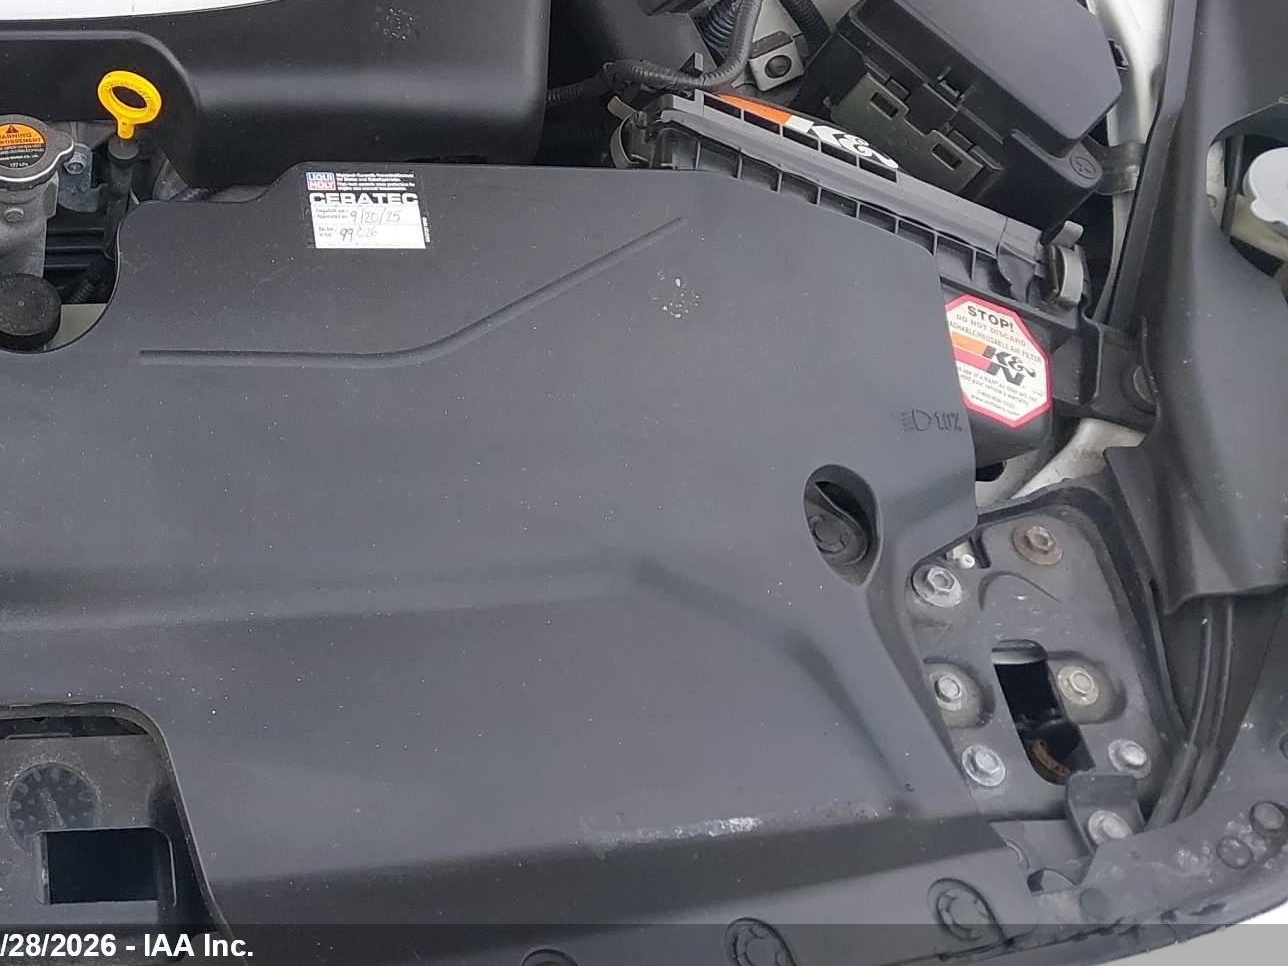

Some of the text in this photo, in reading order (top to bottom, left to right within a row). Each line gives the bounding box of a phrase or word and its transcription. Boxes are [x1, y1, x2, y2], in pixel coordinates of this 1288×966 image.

[309, 193, 418, 204] CERATEC
[956, 314, 1026, 347] DO NOT DISCARD
[967, 305, 1014, 332] STOP!
[949, 321, 1009, 350] ASHABLE/REUSABLE
[983, 346, 1036, 386] K&N
